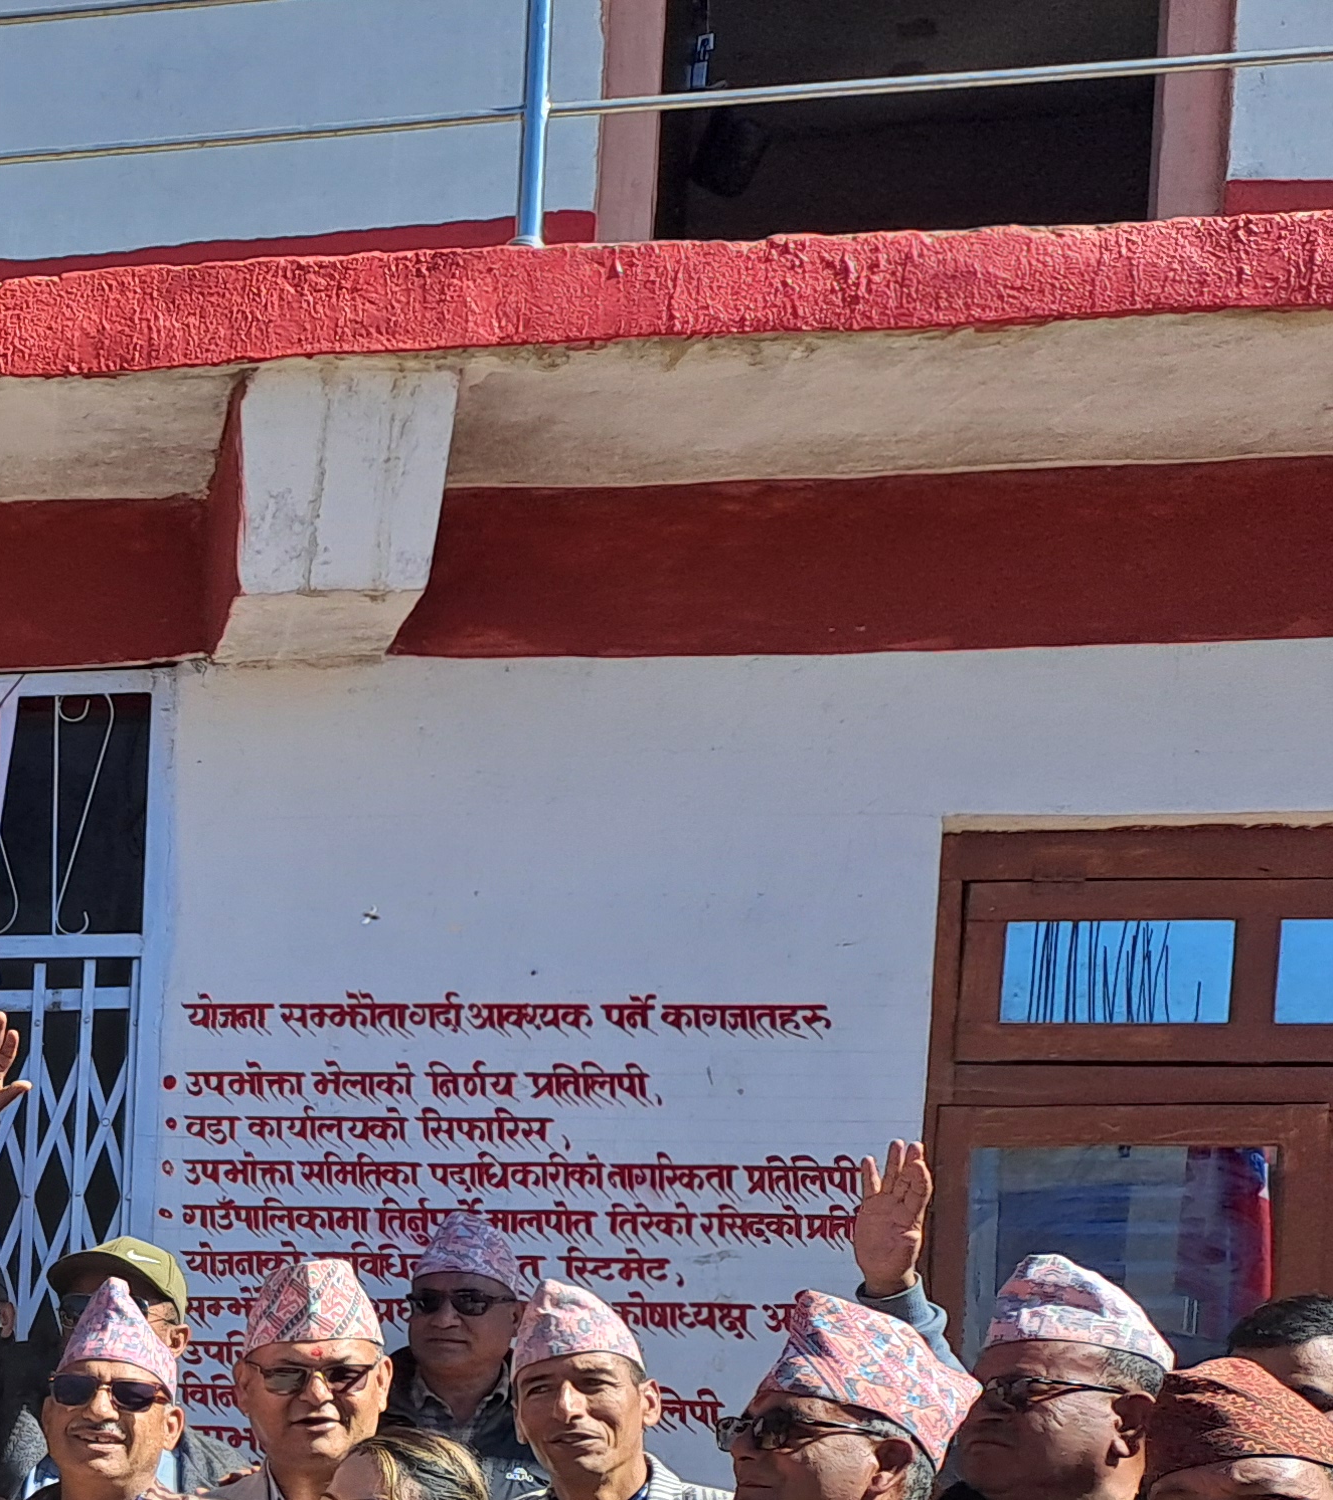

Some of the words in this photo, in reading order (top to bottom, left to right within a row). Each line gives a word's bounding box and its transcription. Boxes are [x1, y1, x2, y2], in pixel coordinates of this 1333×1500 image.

[181, 991, 275, 1037] योजना
[410, 991, 469, 1037] गर्दा
[600, 993, 659, 1038] पर्ने
[185, 1059, 311, 1105] उपभोक्ता
[311, 1059, 419, 1105] भेलाको
[424, 1060, 521, 1106] निर्णय
[183, 1114, 248, 1150] वडा
[245, 1105, 415, 1152] कार्यालयको
[183, 1149, 304, 1195] उपभोक्ता
